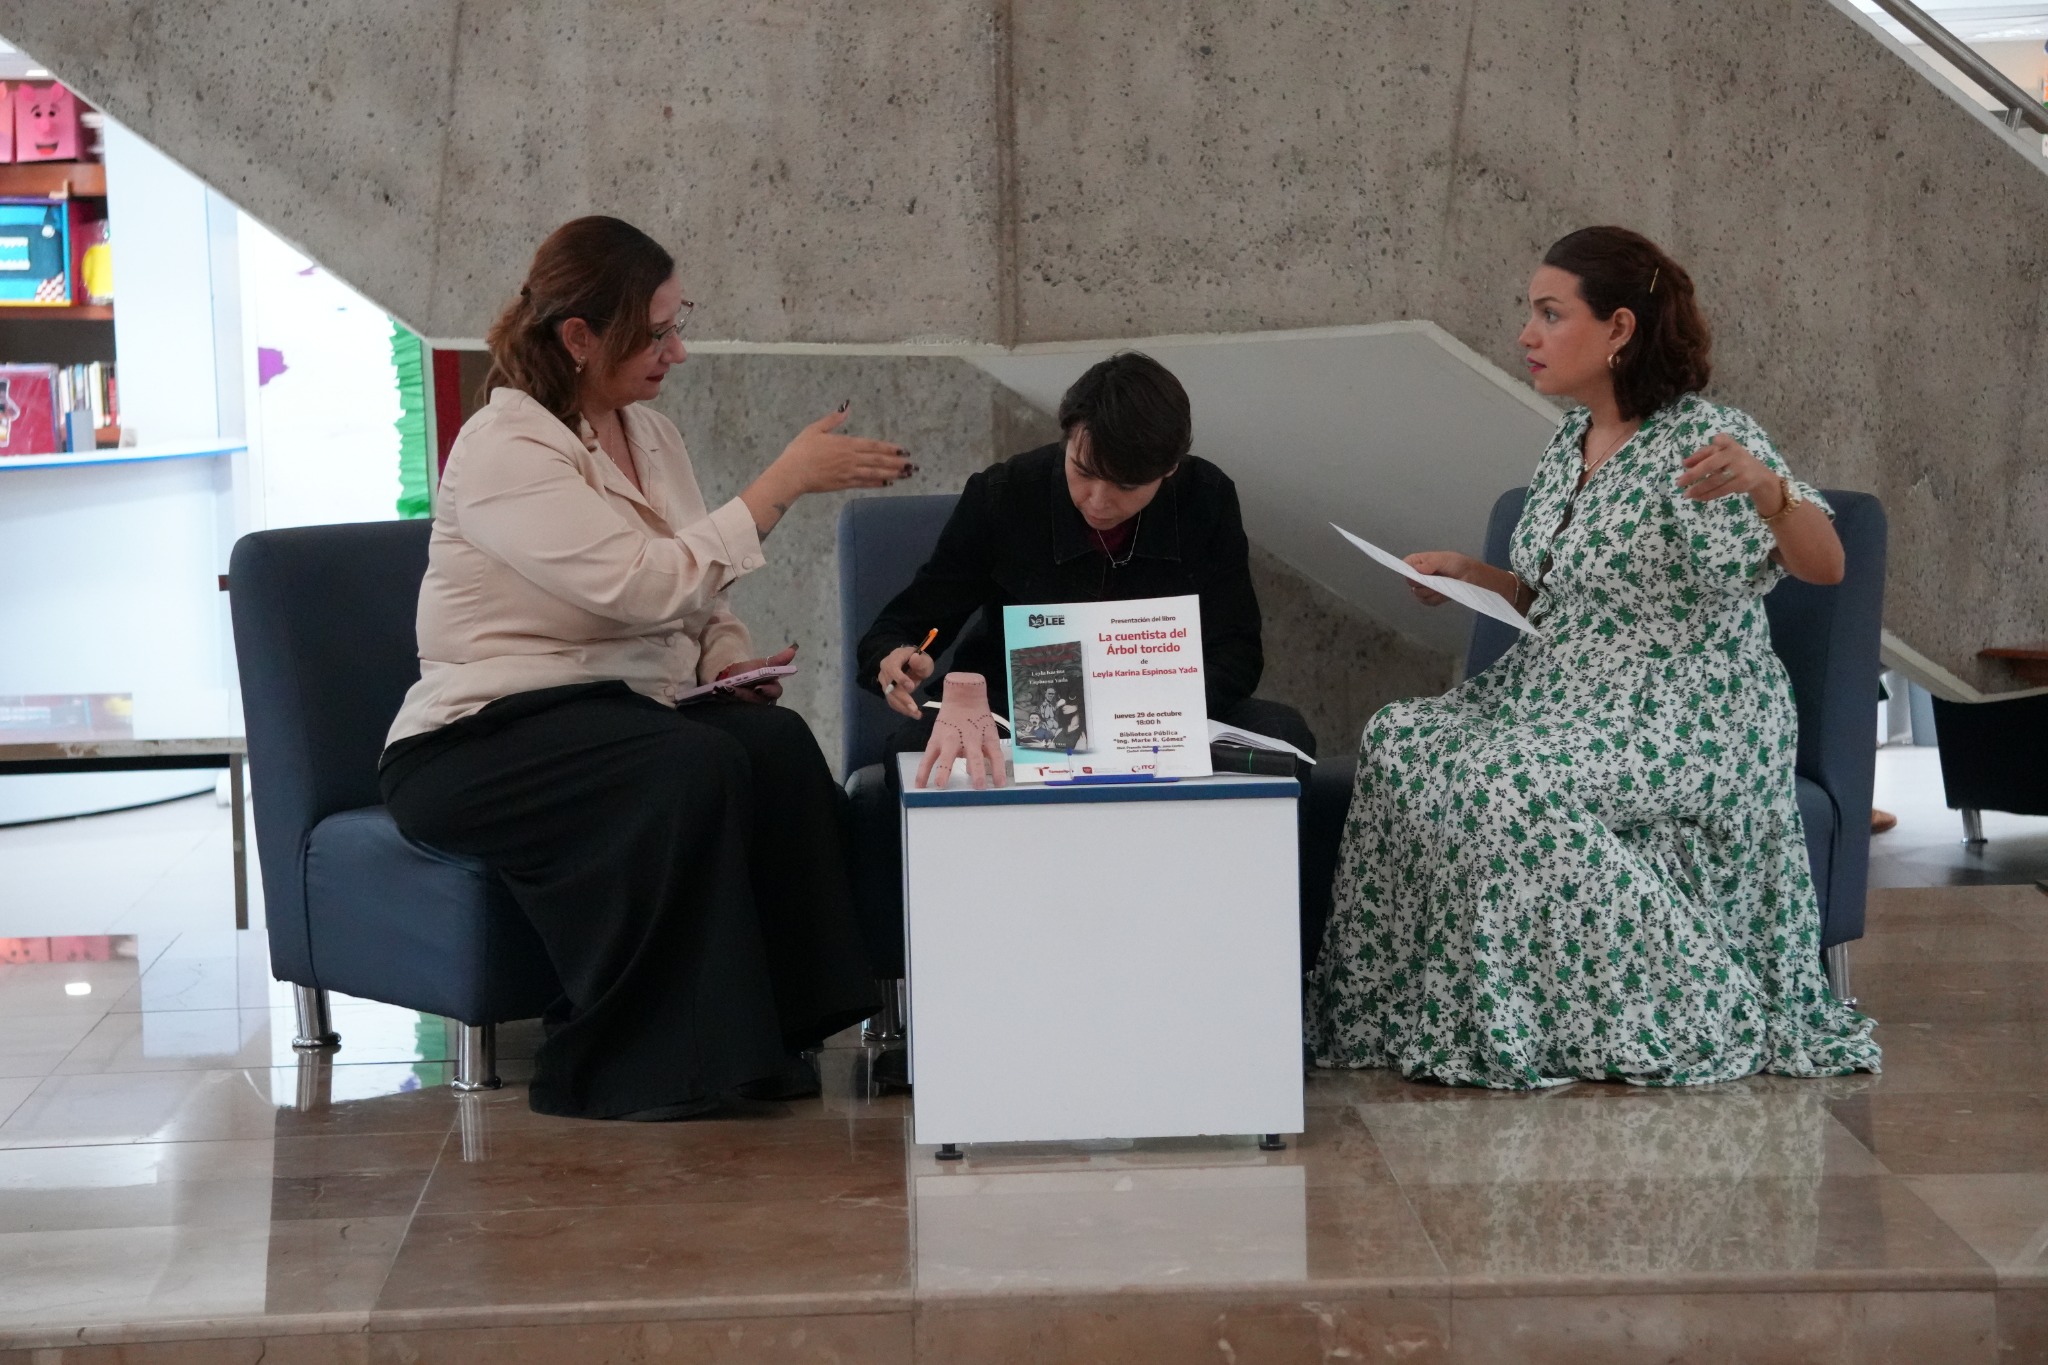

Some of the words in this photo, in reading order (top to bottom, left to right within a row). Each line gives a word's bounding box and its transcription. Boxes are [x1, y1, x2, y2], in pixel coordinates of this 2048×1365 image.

[1099, 633, 1111, 642] La
[1115, 630, 1167, 641] cuentista
[1170, 628, 1187, 638] del
[1106, 644, 1137, 655] Árbol
[1140, 643, 1180, 654] torcido
[1093, 670, 1113, 679] Leyla
[1142, 668, 1176, 676] Espinosa
